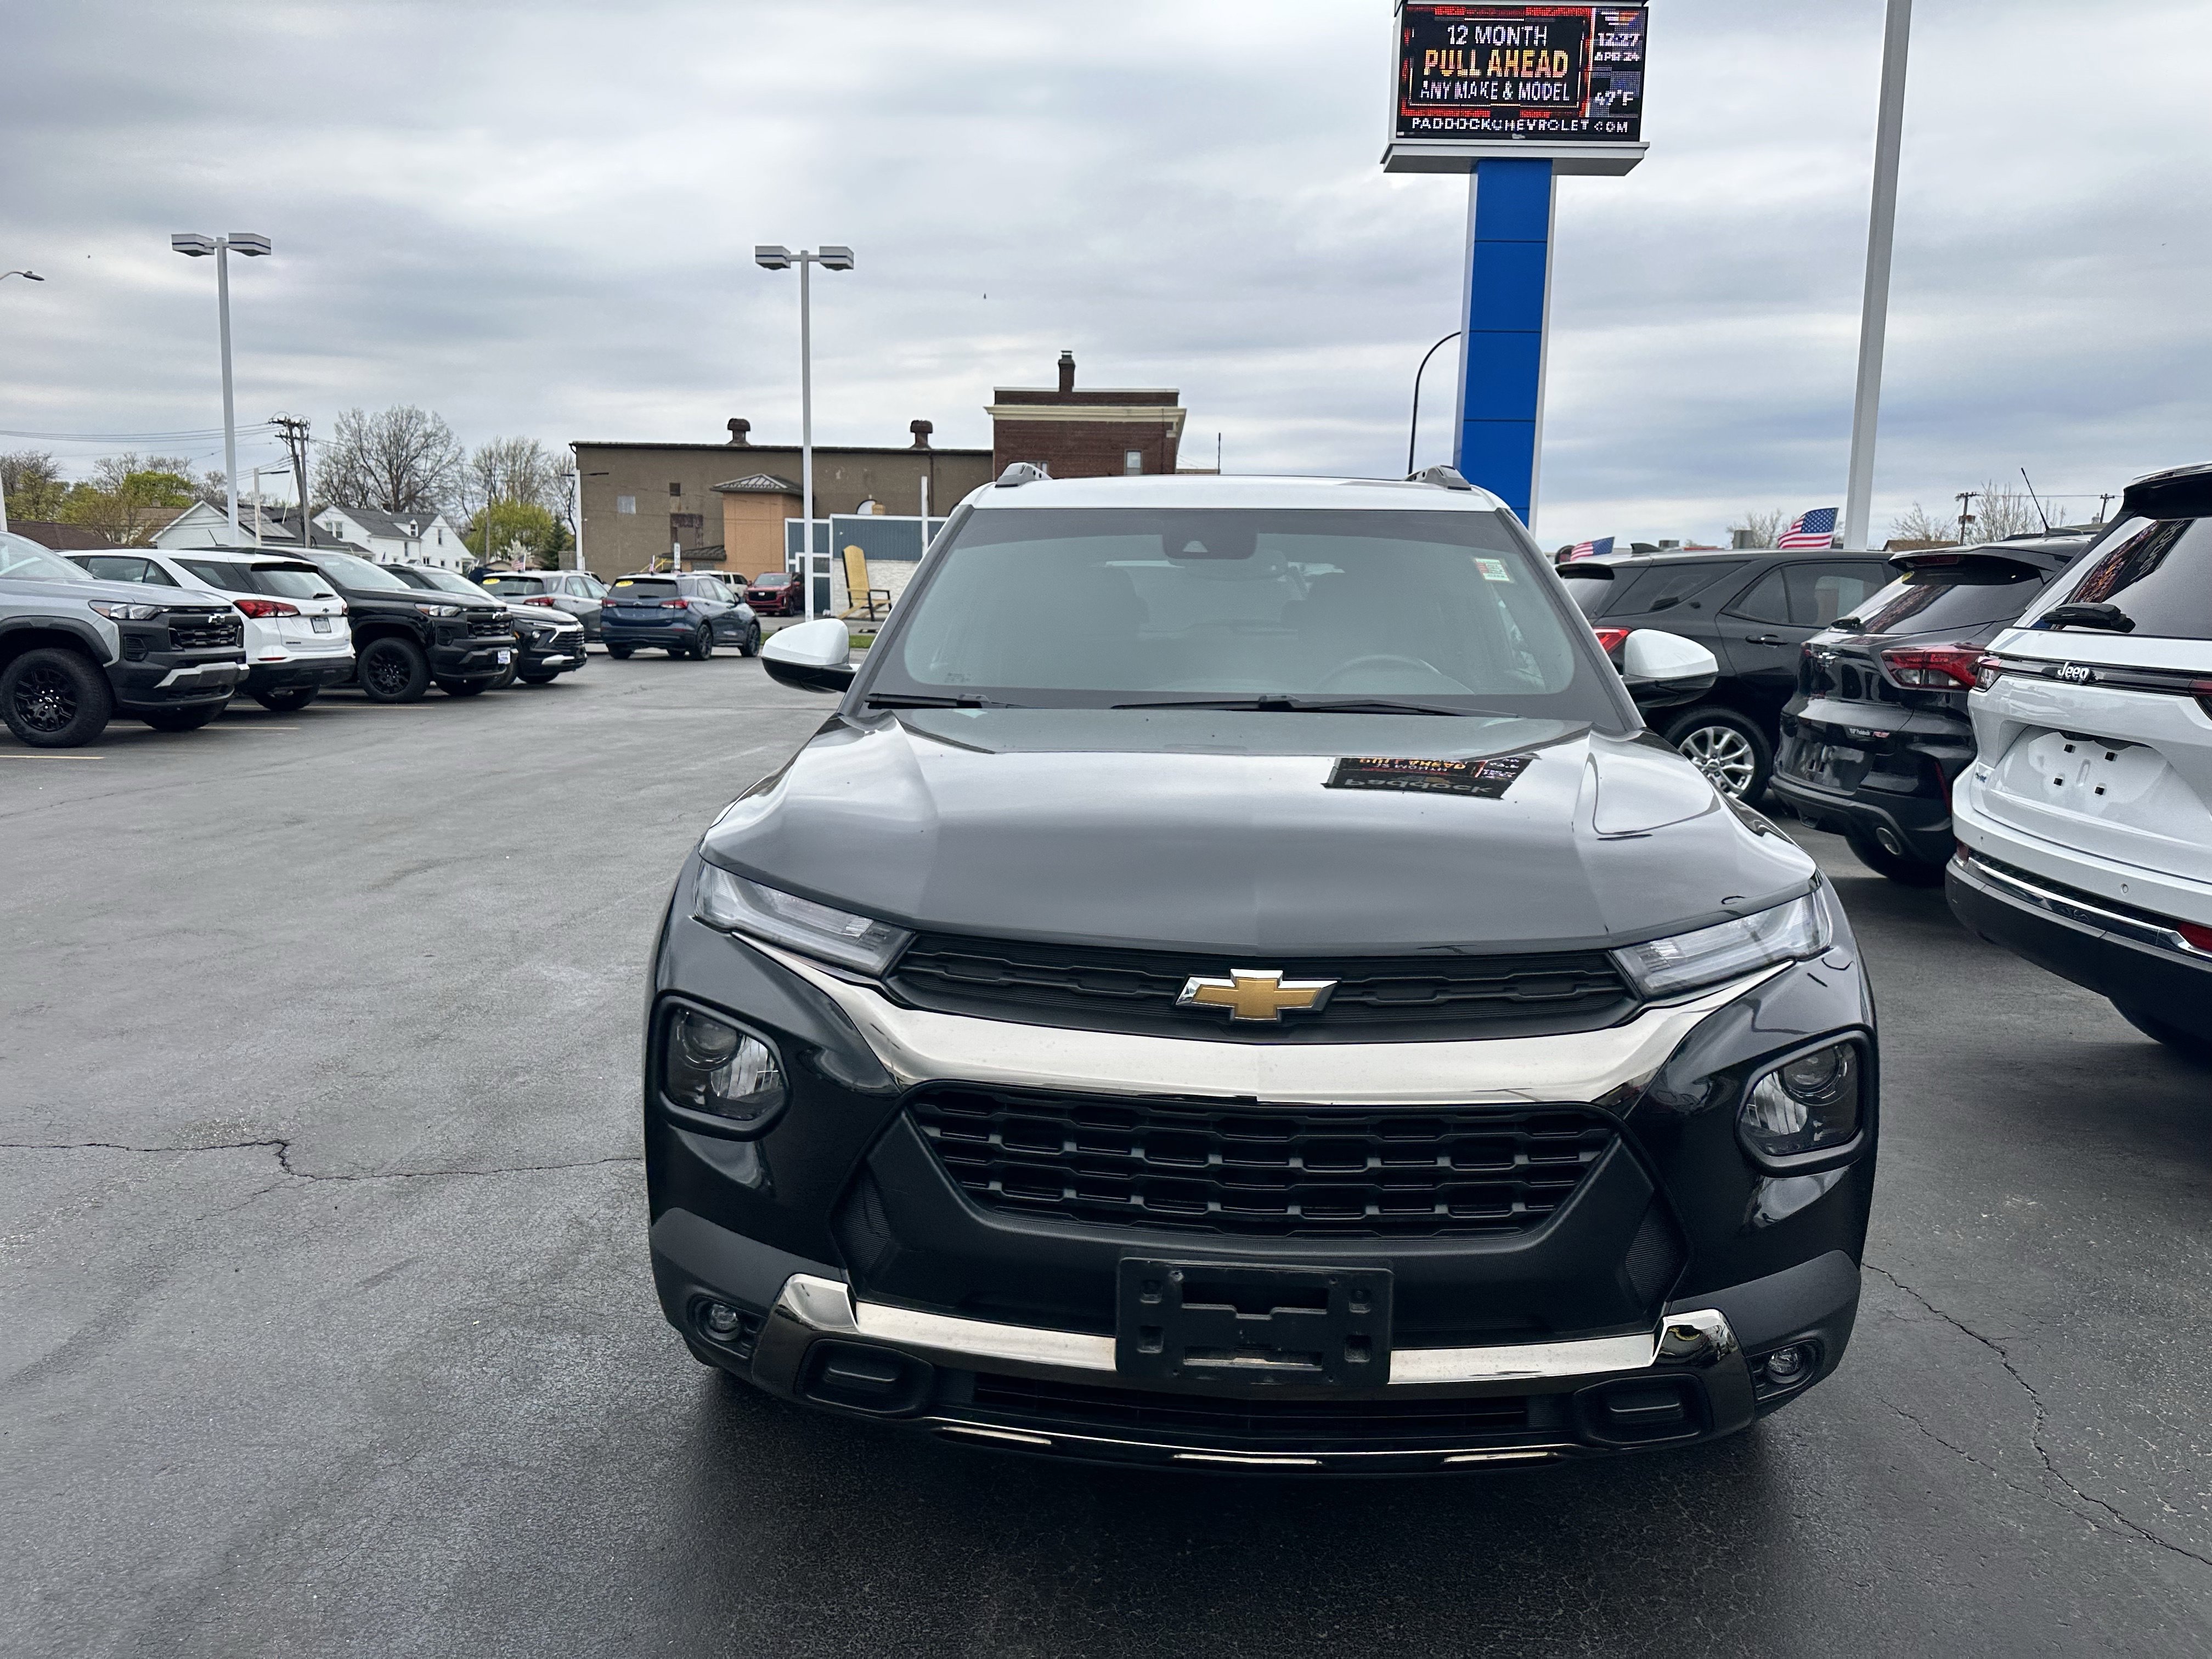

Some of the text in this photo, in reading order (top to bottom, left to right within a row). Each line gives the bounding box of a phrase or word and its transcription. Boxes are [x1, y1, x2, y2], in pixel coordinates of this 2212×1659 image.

[1447, 25, 1547, 46] 12 MONTH
[1423, 49, 1568, 78] PULL AHEAD
[1420, 81, 1570, 101] ANY MAKE & MODEL
[1412, 117, 1629, 133] PADDOCKCHEVROLETCOM
[2057, 661, 2090, 684] Jeep
